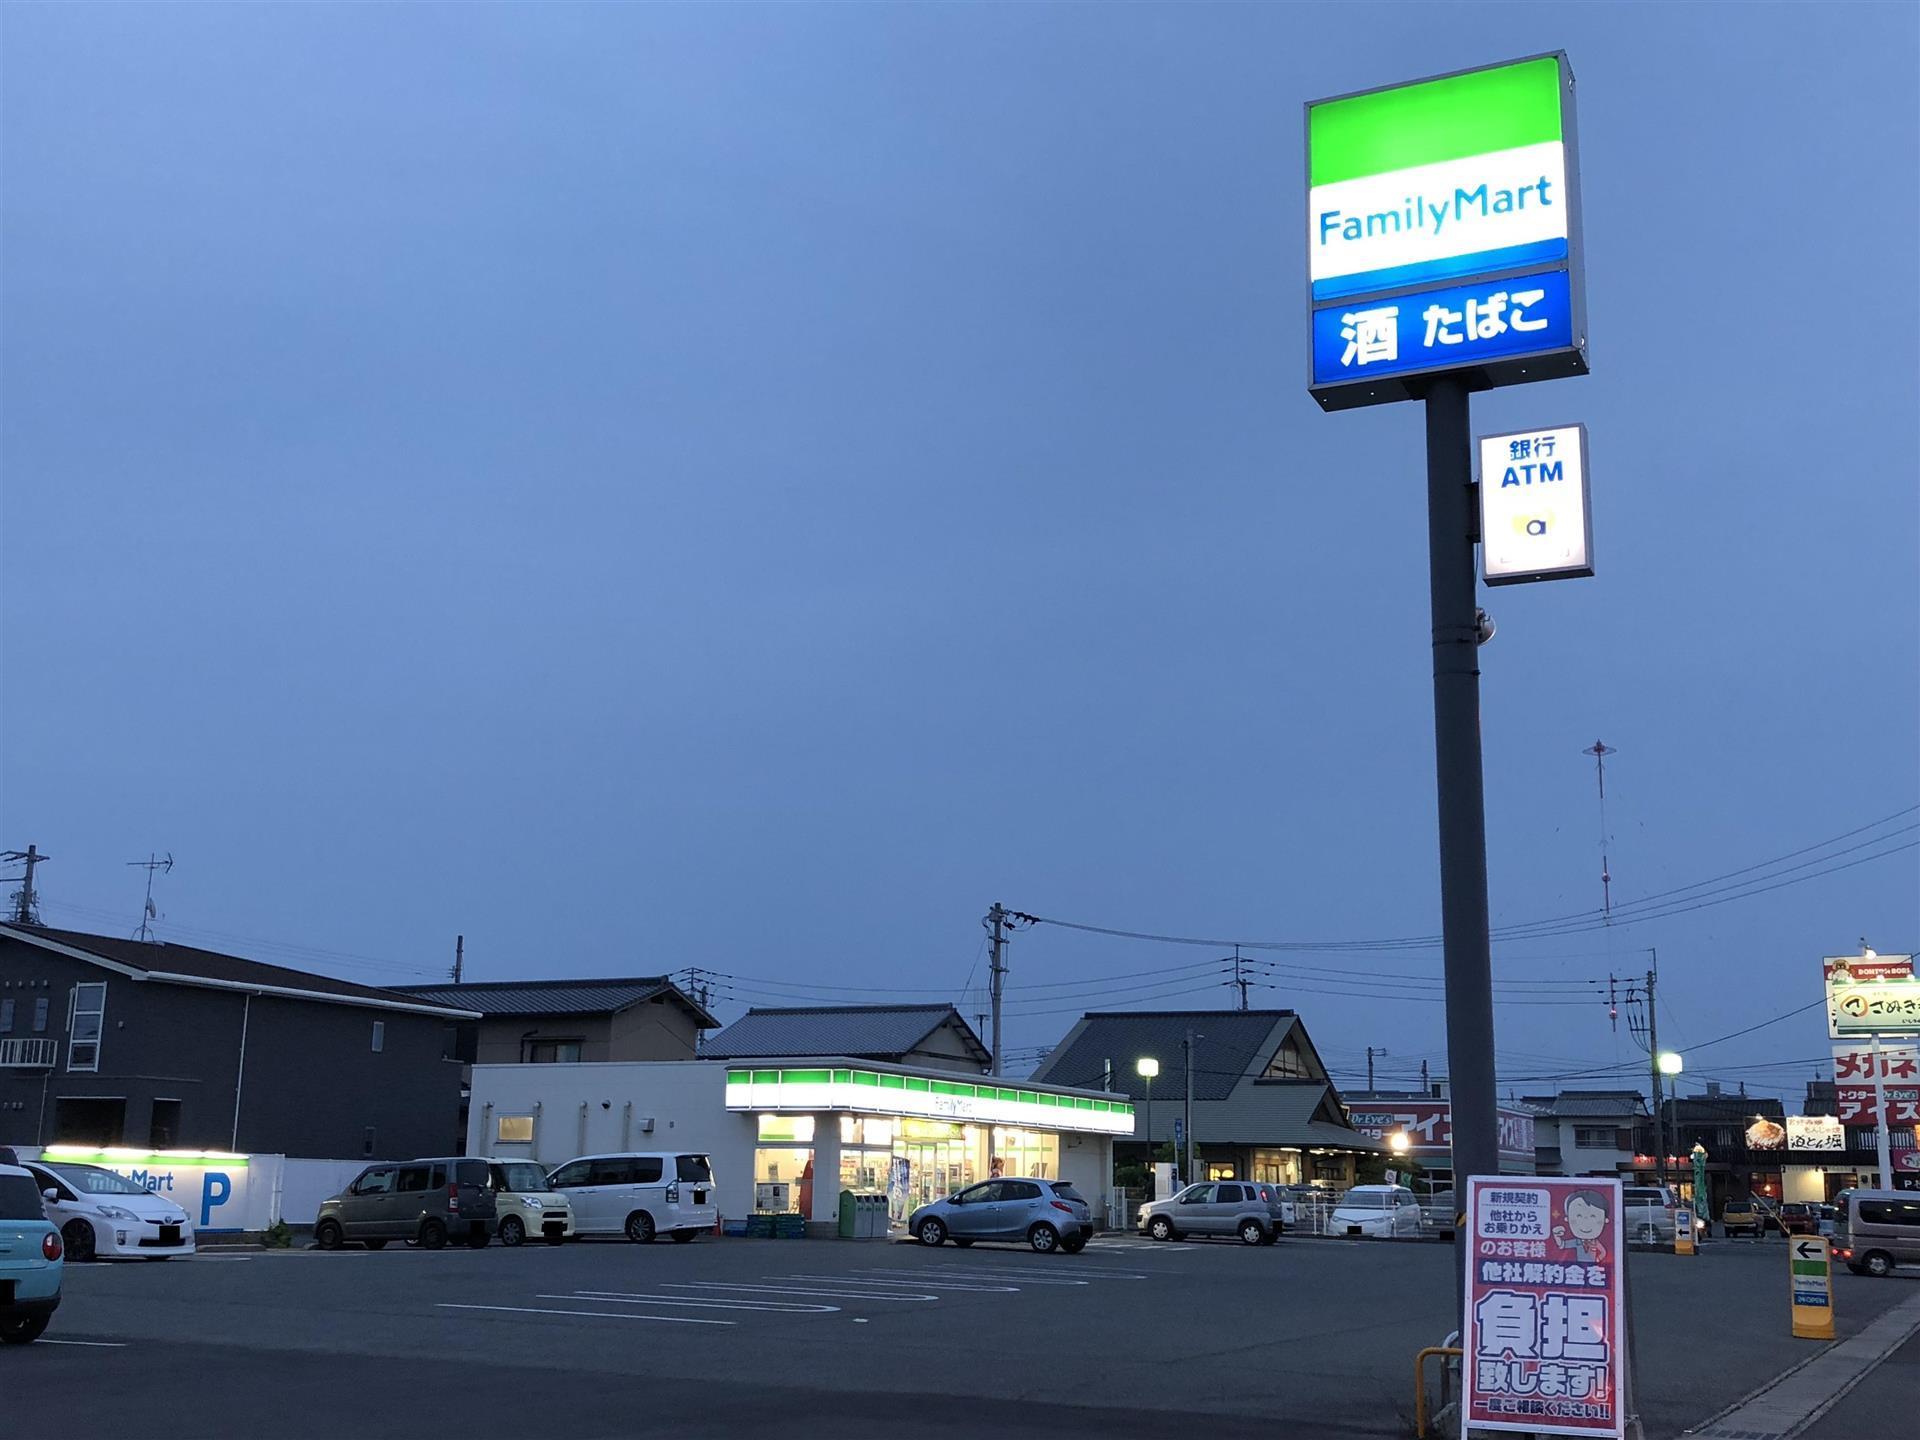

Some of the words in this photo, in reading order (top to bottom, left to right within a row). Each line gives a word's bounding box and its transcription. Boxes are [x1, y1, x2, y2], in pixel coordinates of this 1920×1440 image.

[1319, 175, 1553, 246] FamilyMart
[1340, 306, 1400, 367] 酒
[1422, 289, 1549, 348] たばこ
[1509, 436, 1556, 461] 銀行
[1501, 461, 1564, 488] ATM
[1836, 1051, 1917, 1079] メガネ
[1839, 1101, 1920, 1120] アイズ
[200, 1172, 231, 1226] P
[1490, 1192, 1538, 1204] 新規契約
[1484, 1222, 1544, 1235] お乗りかえ
[1490, 1210, 1537, 1223] 他社から
[1480, 1241, 1546, 1258] のお客様
[1482, 1262, 1606, 1286] 他社解約金を
[1477, 1292, 1608, 1362] 負担
